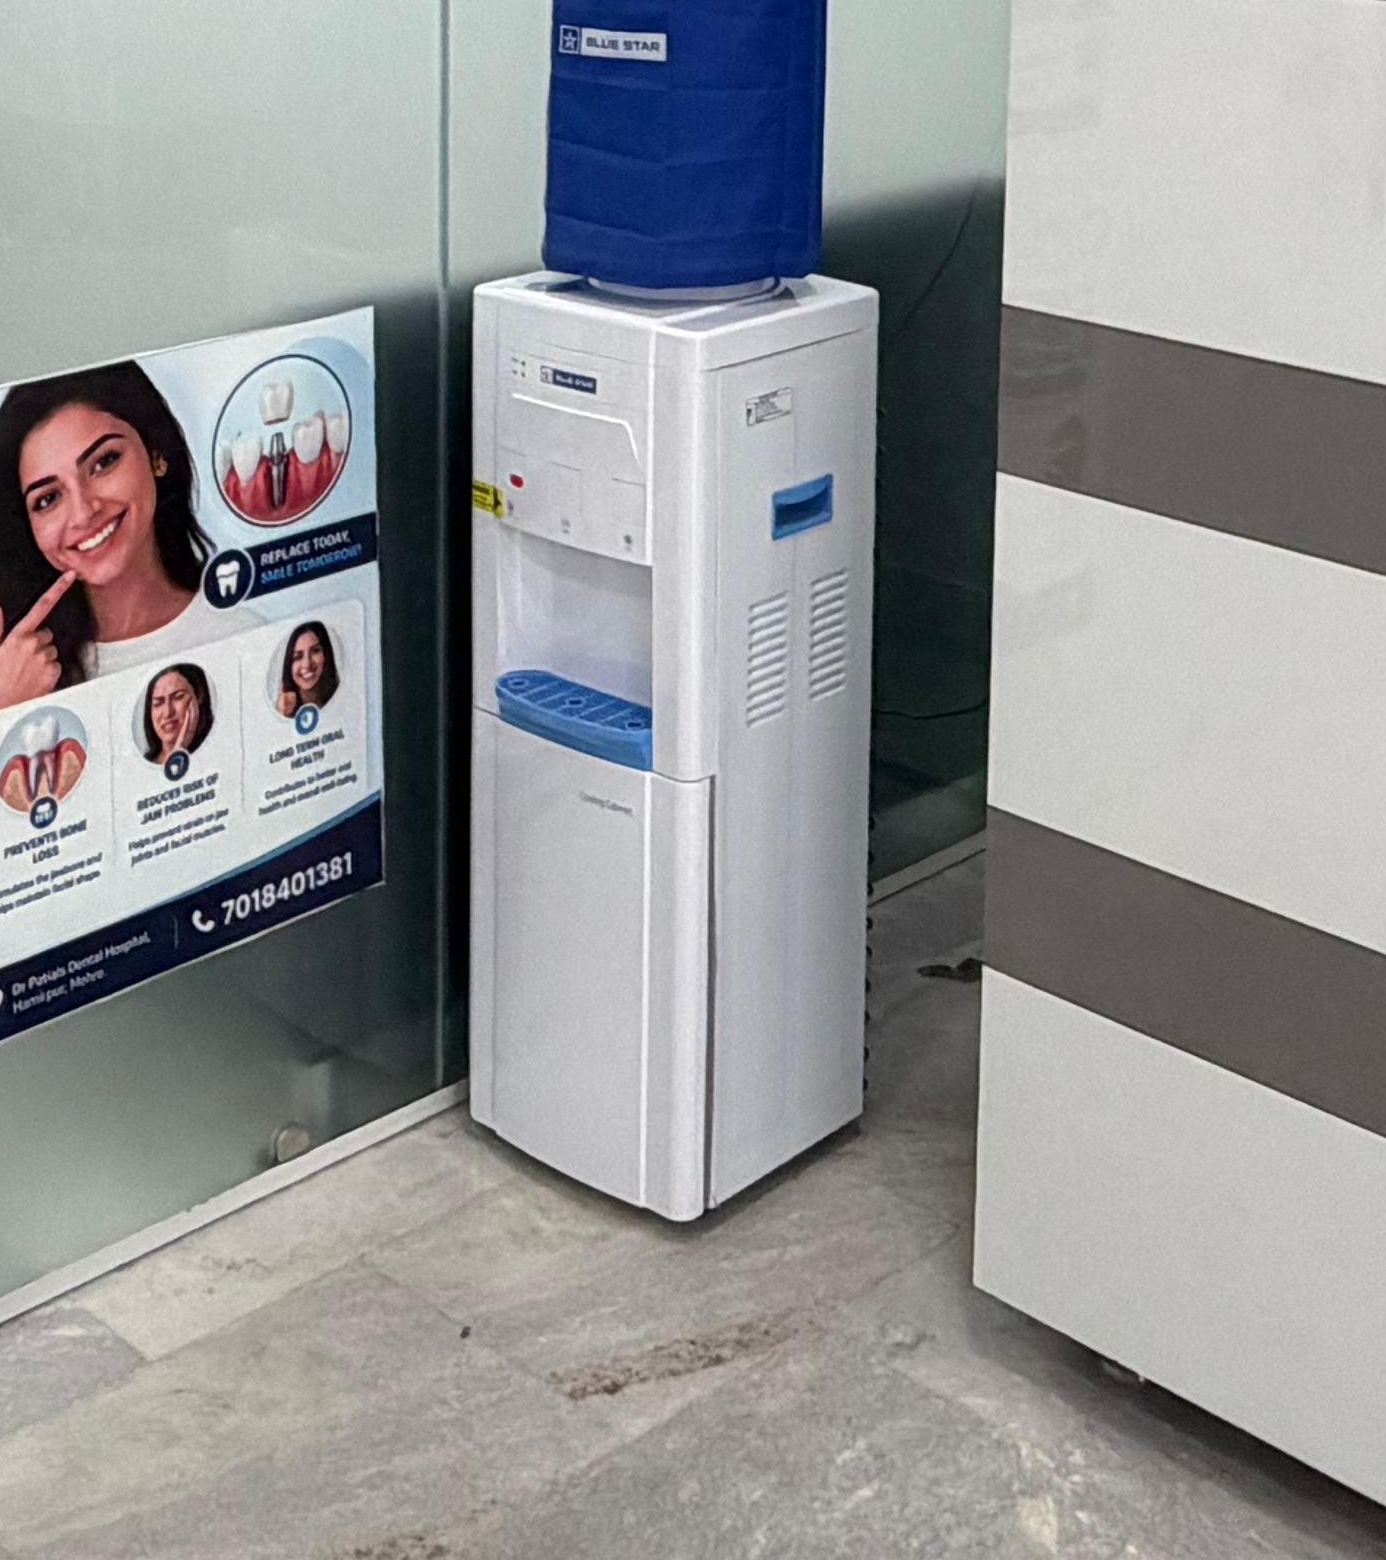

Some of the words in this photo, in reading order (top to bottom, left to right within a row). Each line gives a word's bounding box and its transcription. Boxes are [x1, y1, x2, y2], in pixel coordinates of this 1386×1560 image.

[586, 37, 619, 50] BLUE
[623, 40, 660, 51] STAR
[33, 846, 59, 863] LOSS
[221, 852, 353, 925] 7018401381
